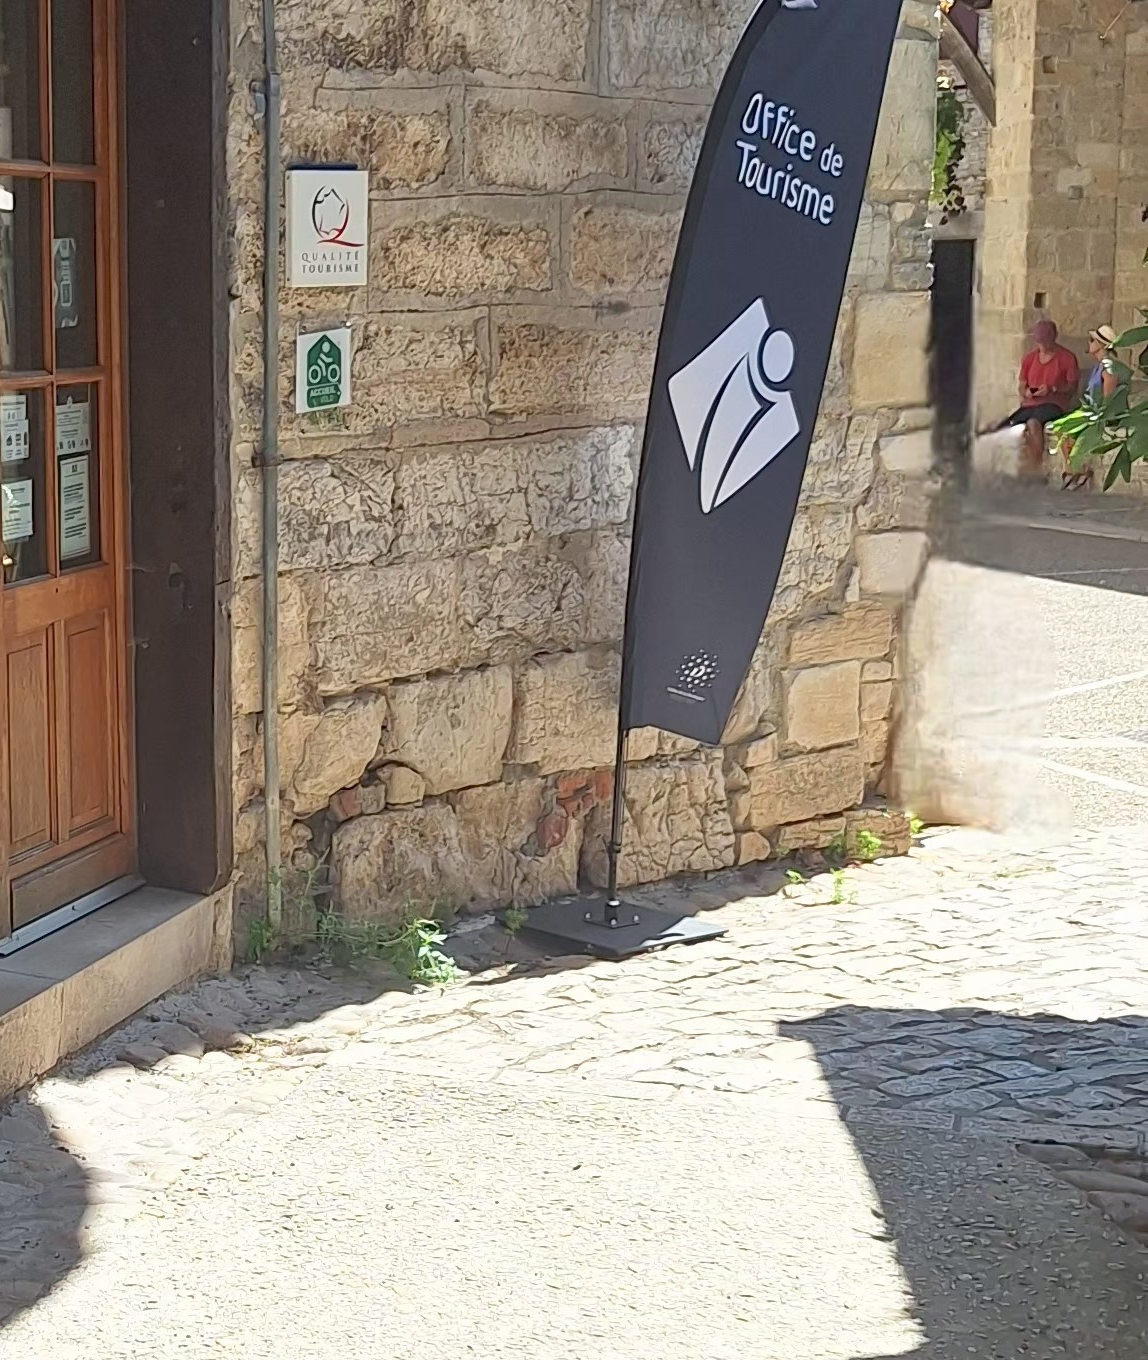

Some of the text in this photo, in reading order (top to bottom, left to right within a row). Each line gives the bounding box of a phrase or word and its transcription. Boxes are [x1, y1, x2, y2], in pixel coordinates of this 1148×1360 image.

[741, 92, 844, 177] Office de
[735, 139, 835, 225] Tourisme
[301, 250, 359, 263] QUALITÉ
[302, 263, 359, 274] TOURISME
